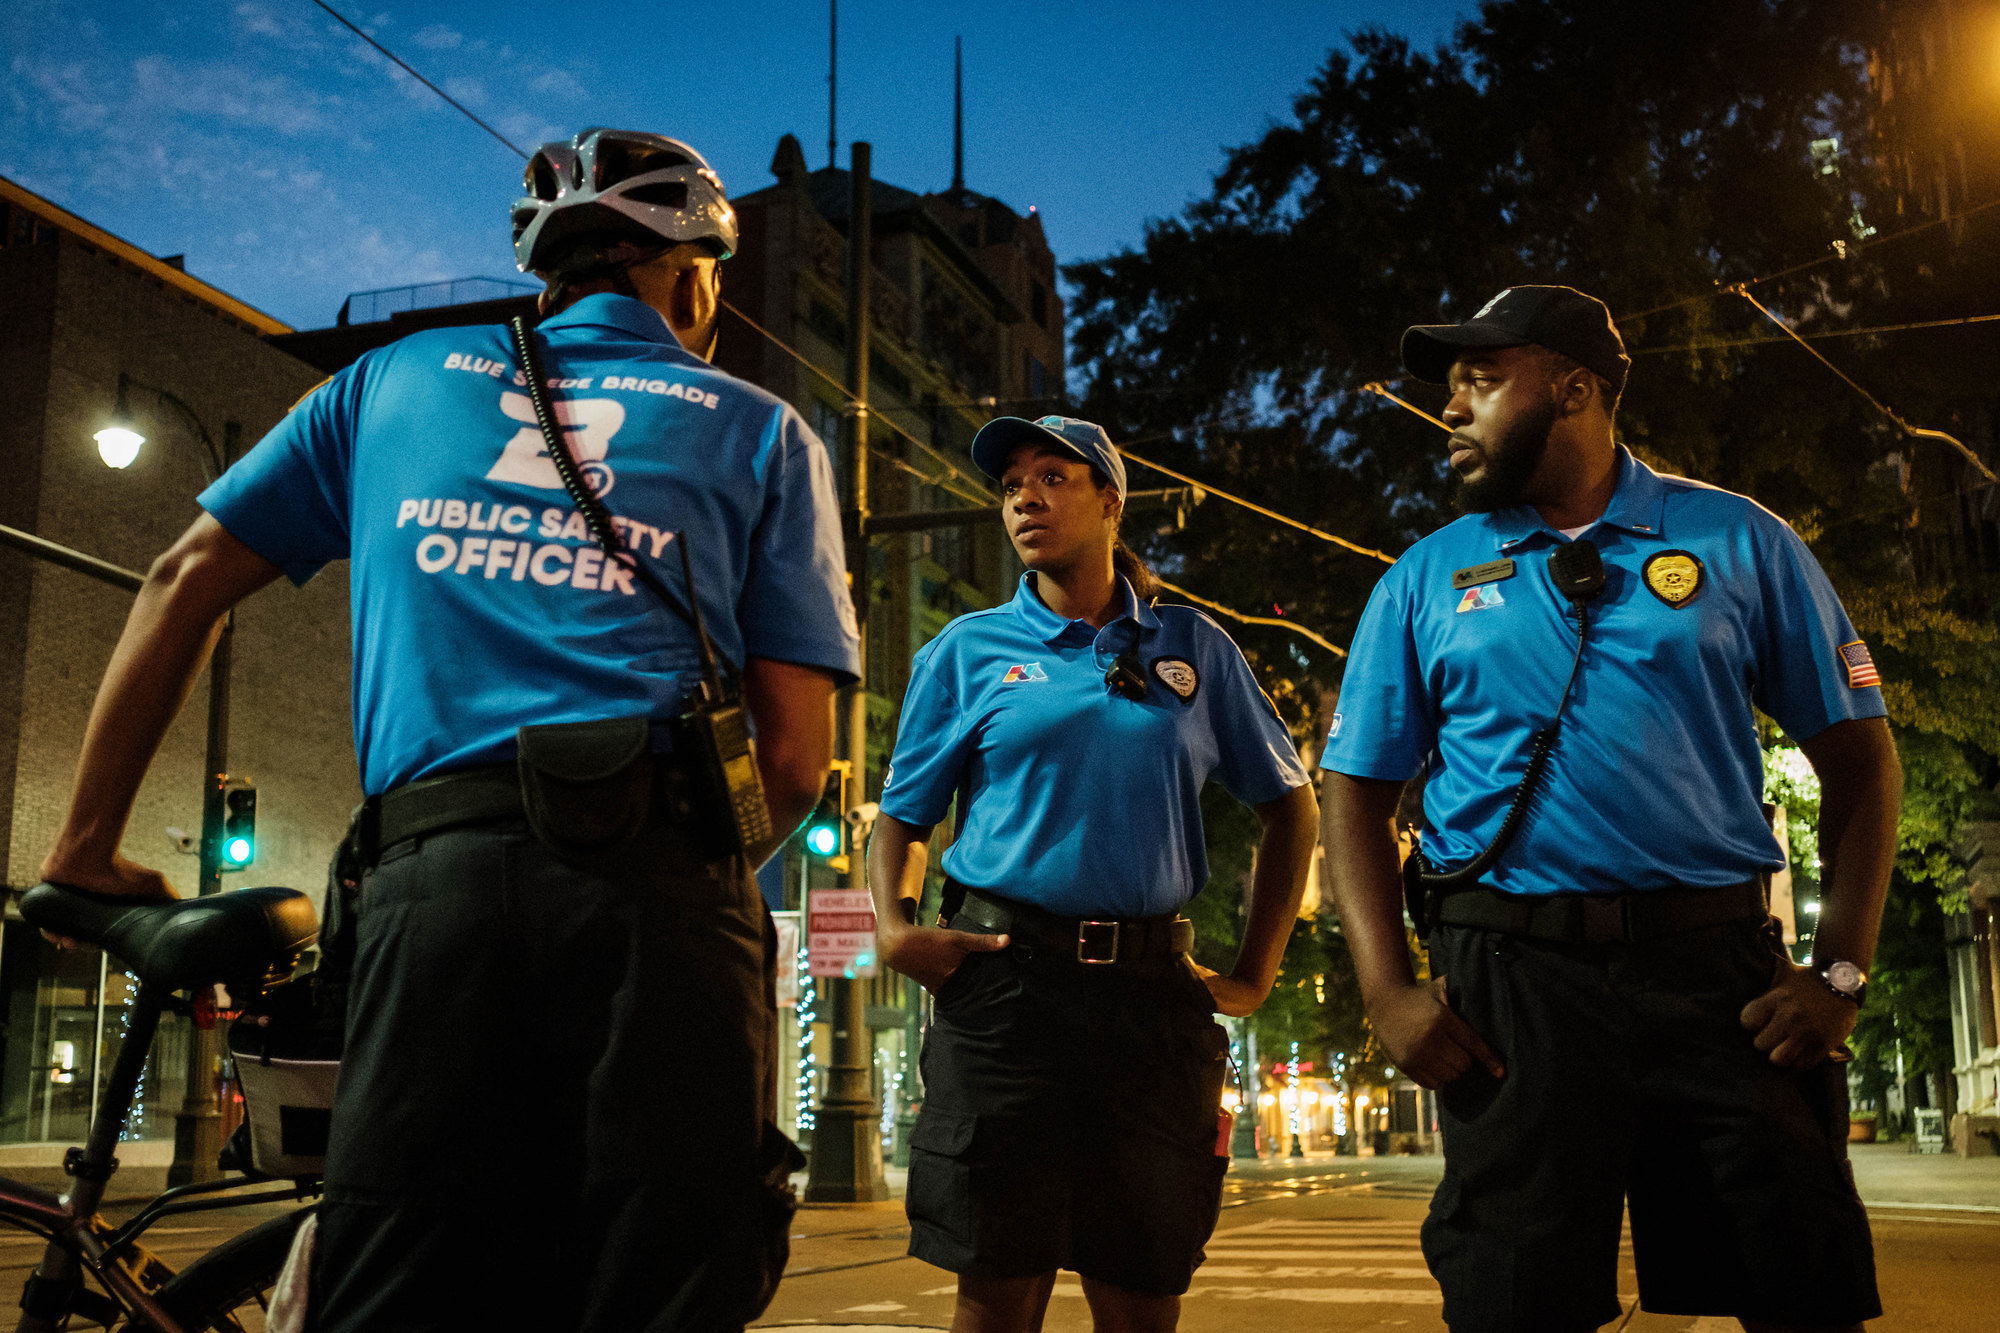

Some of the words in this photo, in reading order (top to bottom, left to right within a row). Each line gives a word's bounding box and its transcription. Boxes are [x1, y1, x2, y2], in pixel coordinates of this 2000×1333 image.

[444, 353, 505, 378] BLUE
[513, 369, 593, 389] SEDE
[601, 376, 720, 410] BRIGADE
[396, 499, 532, 534] PUBLIC
[538, 508, 674, 559] SAETY
[416, 533, 637, 596] OFFICER
